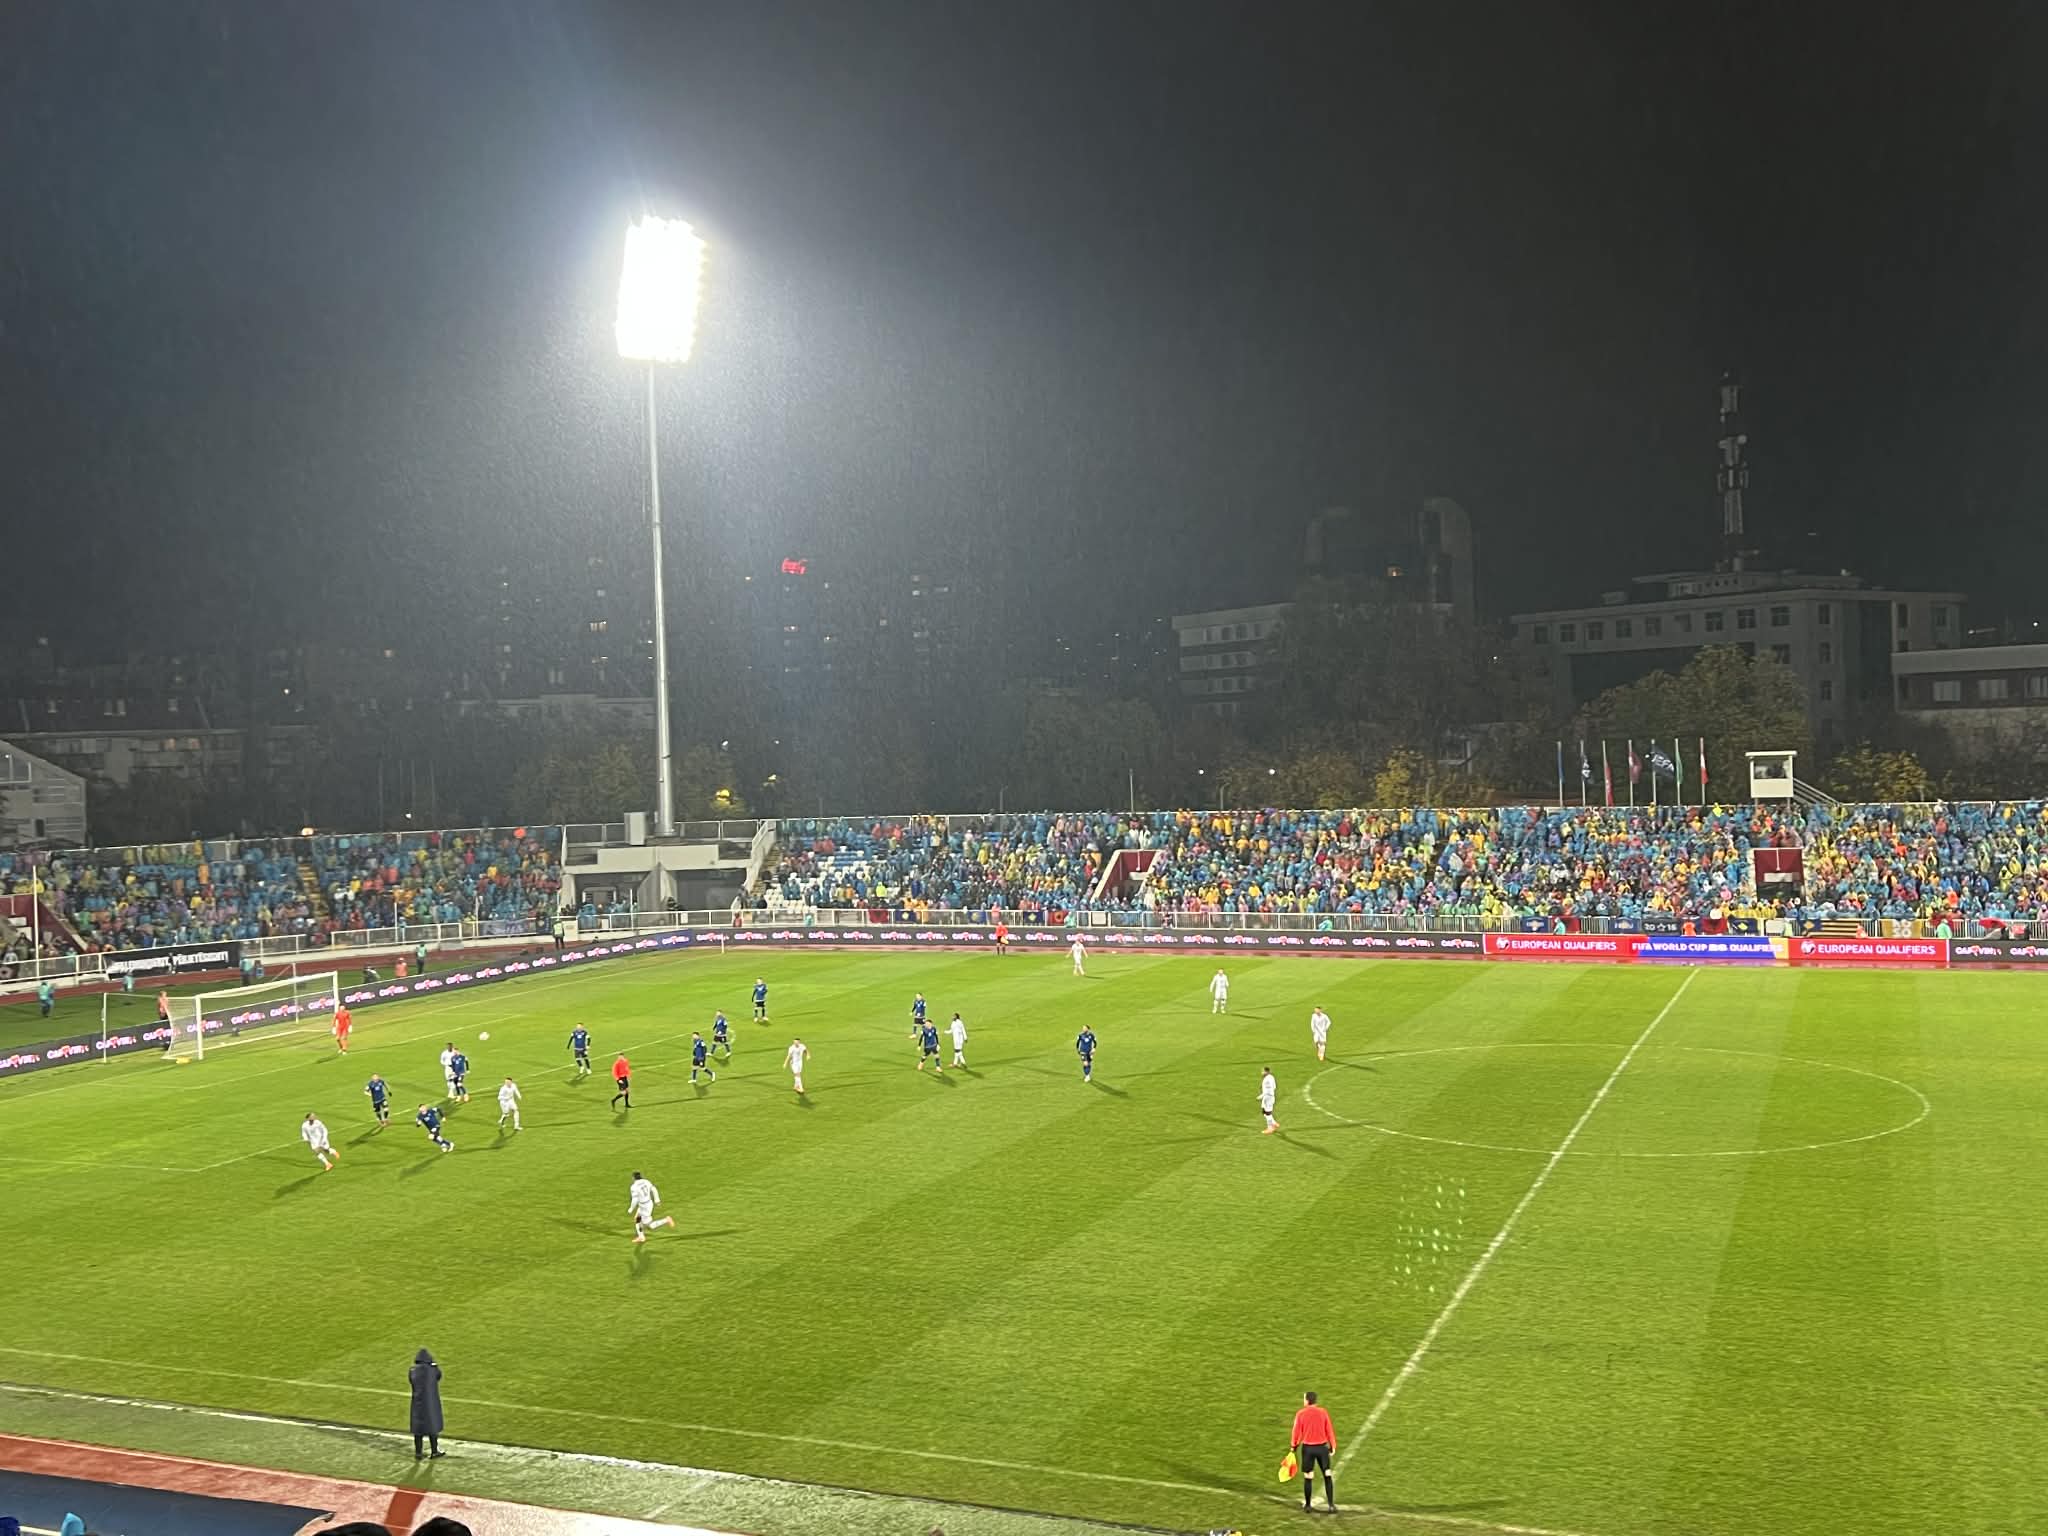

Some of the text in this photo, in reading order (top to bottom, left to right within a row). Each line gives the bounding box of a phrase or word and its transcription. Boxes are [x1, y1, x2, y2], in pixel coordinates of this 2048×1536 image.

[1512, 940, 1617, 951] EUROPEAN QUALIFIERS
[1632, 942, 1652, 951] FIFA
[1652, 943, 1687, 952] WORLD
[1688, 943, 1708, 952] CUP
[1729, 943, 1783, 953] QUALIFIERS
[1818, 944, 1936, 955] EUROPEAN QUALIFIERS
